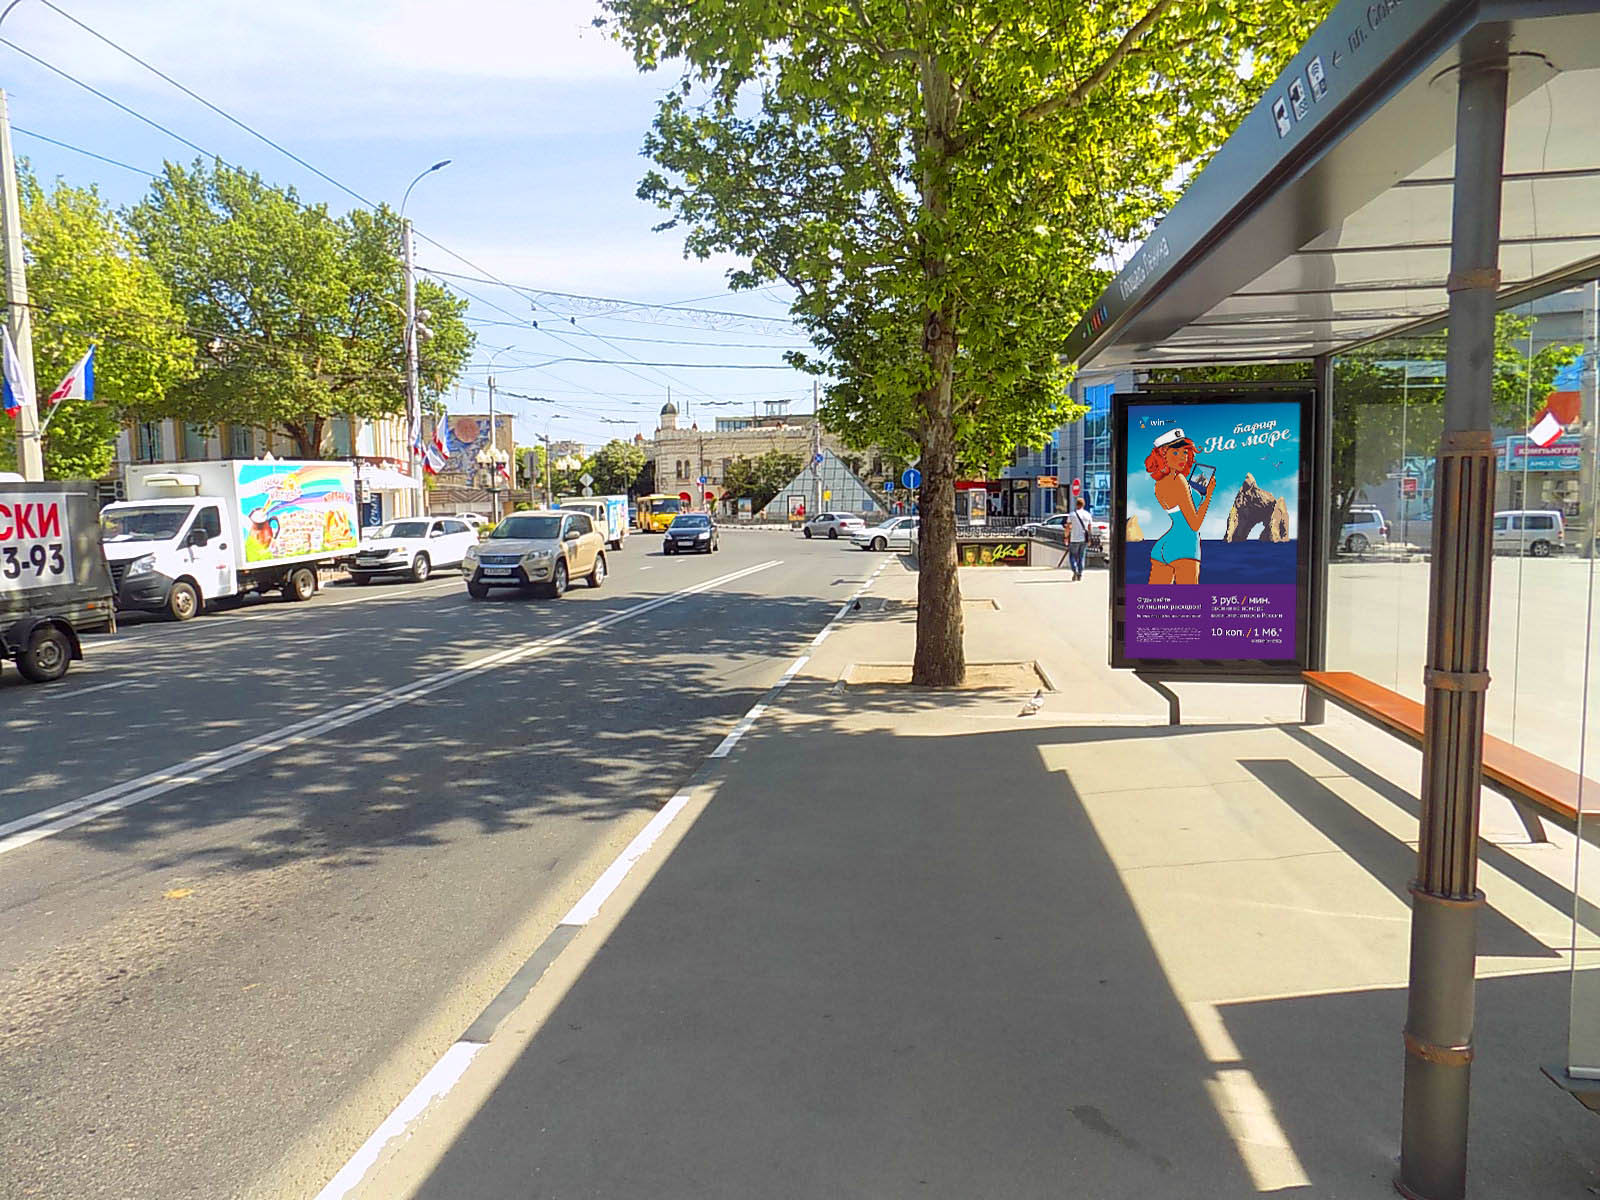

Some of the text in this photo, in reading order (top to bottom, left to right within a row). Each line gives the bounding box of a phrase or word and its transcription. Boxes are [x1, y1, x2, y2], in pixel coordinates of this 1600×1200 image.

[1150, 418, 1165, 426] win
[1233, 419, 1277, 435] тариф
[1204, 428, 1292, 454] На море
[1211, 595, 1218, 605] 3
[1220, 595, 1240, 606] руб.
[1248, 597, 1271, 605] мин.
[1211, 627, 1223, 637] 10
[1225, 629, 1245, 637] коп.
[1254, 628, 1259, 637] 1
